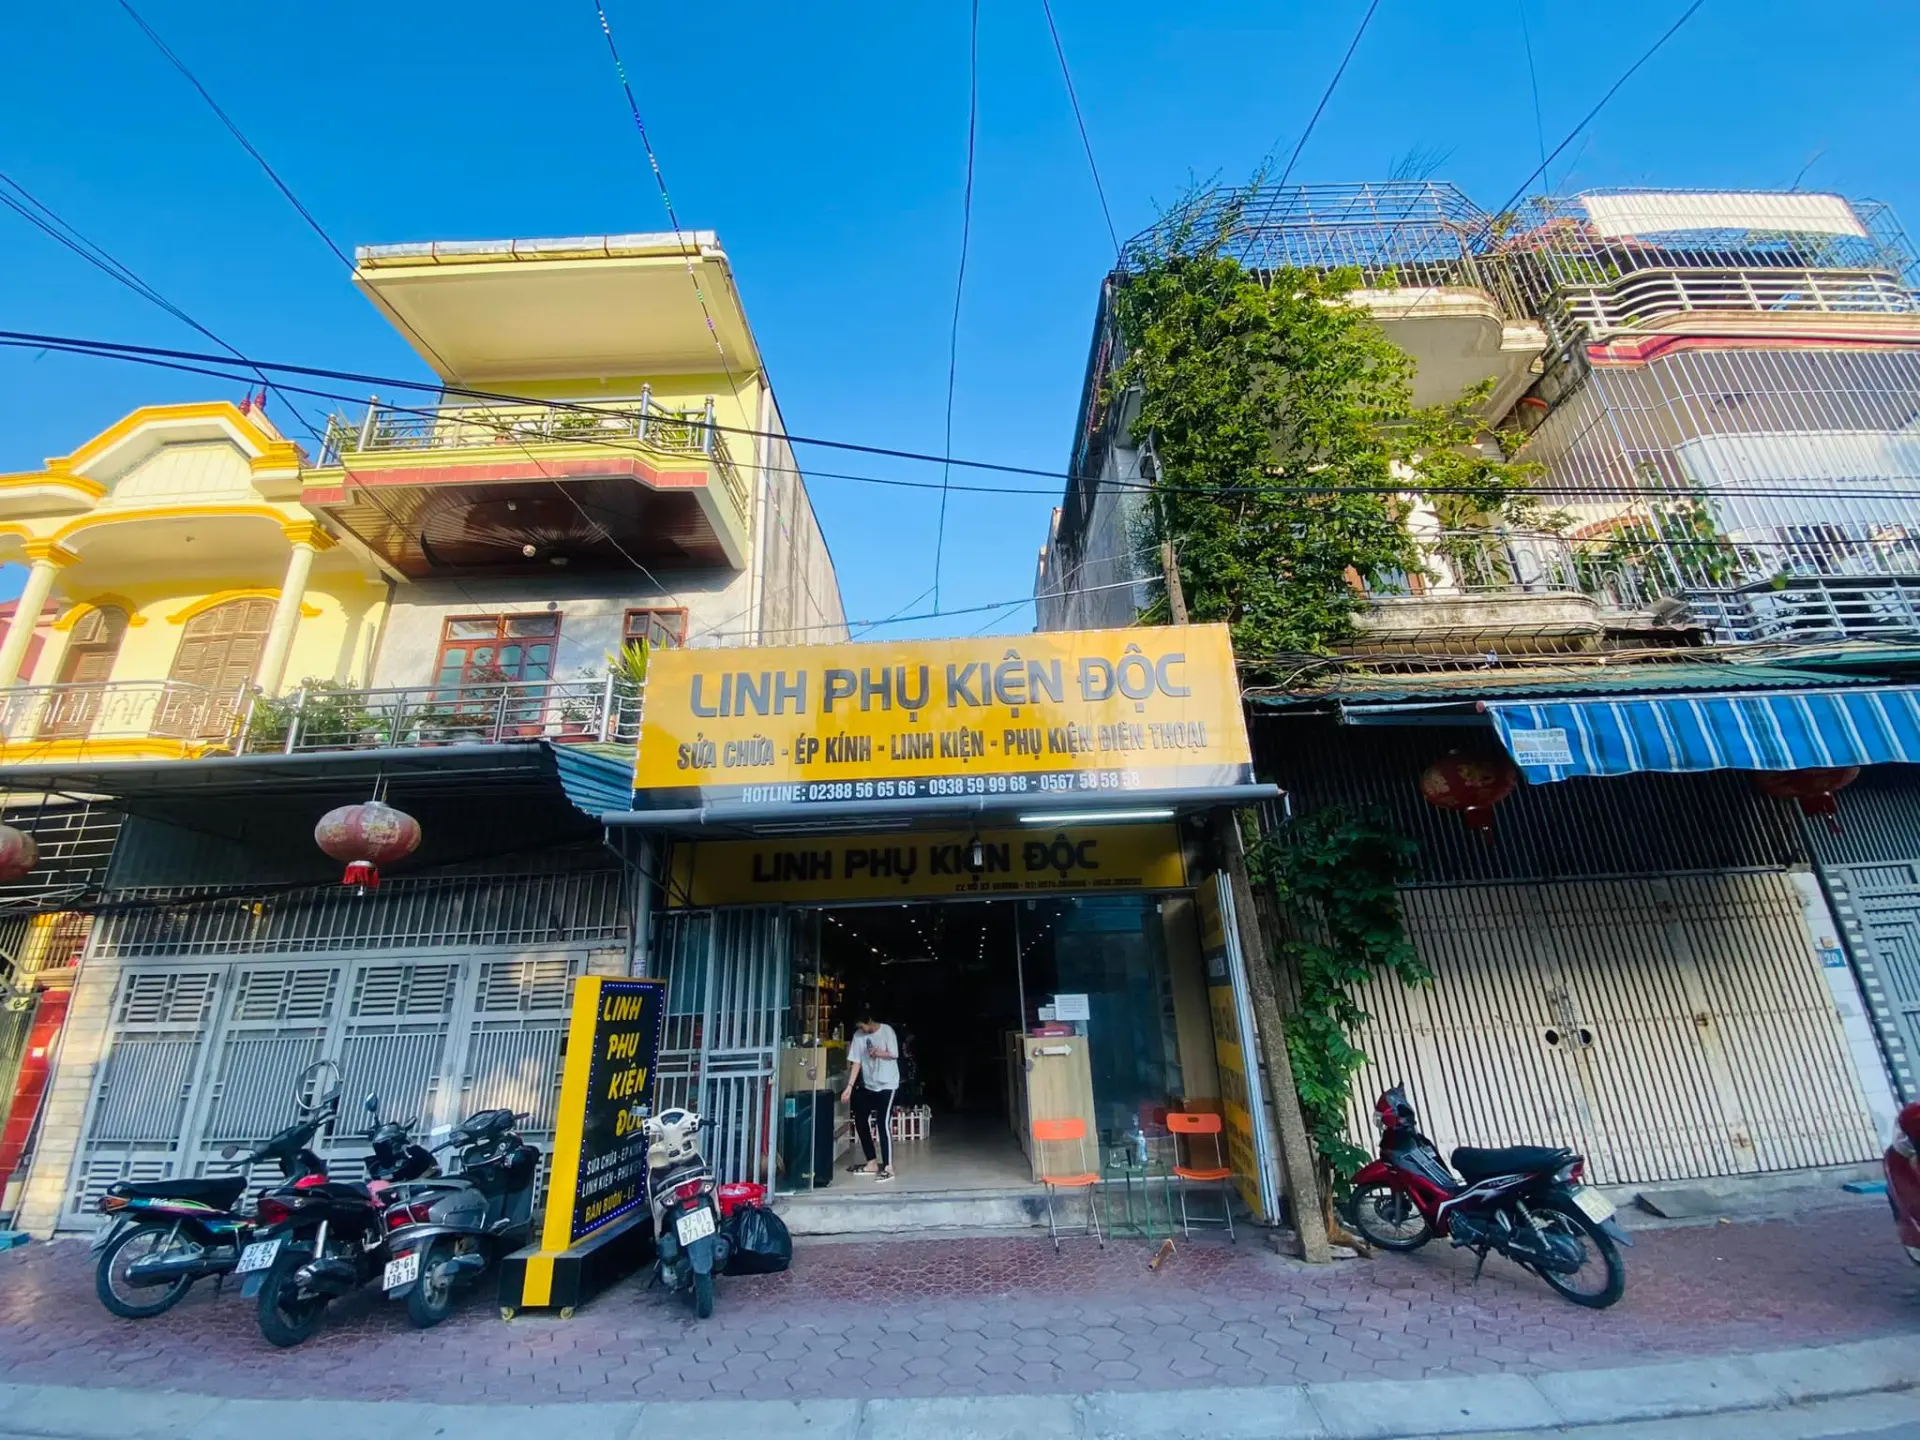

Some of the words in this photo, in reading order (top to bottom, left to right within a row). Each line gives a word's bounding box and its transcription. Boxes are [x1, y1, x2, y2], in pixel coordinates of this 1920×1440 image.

[690, 670, 807, 718] LINH
[823, 665, 929, 722] PHỤ
[946, 649, 1064, 718] KIỆN
[1076, 643, 1191, 713] ĐỘC
[677, 732, 716, 770] SỬA
[723, 733, 775, 767] CHỮA
[794, 732, 820, 765] ÉP
[825, 731, 871, 763] KÍNH
[891, 732, 934, 760] LINH
[940, 726, 984, 763] KIỆN
[1004, 727, 1042, 760] PHỤ
[1048, 721, 1093, 760] KIỆN
[1148, 721, 1208, 754] THOẠI
[742, 786, 806, 803] HOTLINE:
[809, 782, 852, 801] 02388
[855, 781, 873, 799] 56
[876, 780, 895, 798] 65
[898, 779, 916, 797] 66
[929, 777, 963, 795] 0938
[967, 776, 984, 793] 59
[988, 775, 1006, 792] 99
[1009, 775, 1027, 792] 68
[1040, 773, 1075, 791] 0567
[1079, 772, 1096, 789] 58
[1100, 771, 1118, 788] 58
[752, 850, 832, 882] LINH
[845, 846, 917, 884] PHỤ
[1023, 832, 1098, 878] ĐỘC
[603, 996, 643, 1021] LINH
[606, 1032, 640, 1063] PHỤ
[607, 1062, 648, 1100] KIỆN
